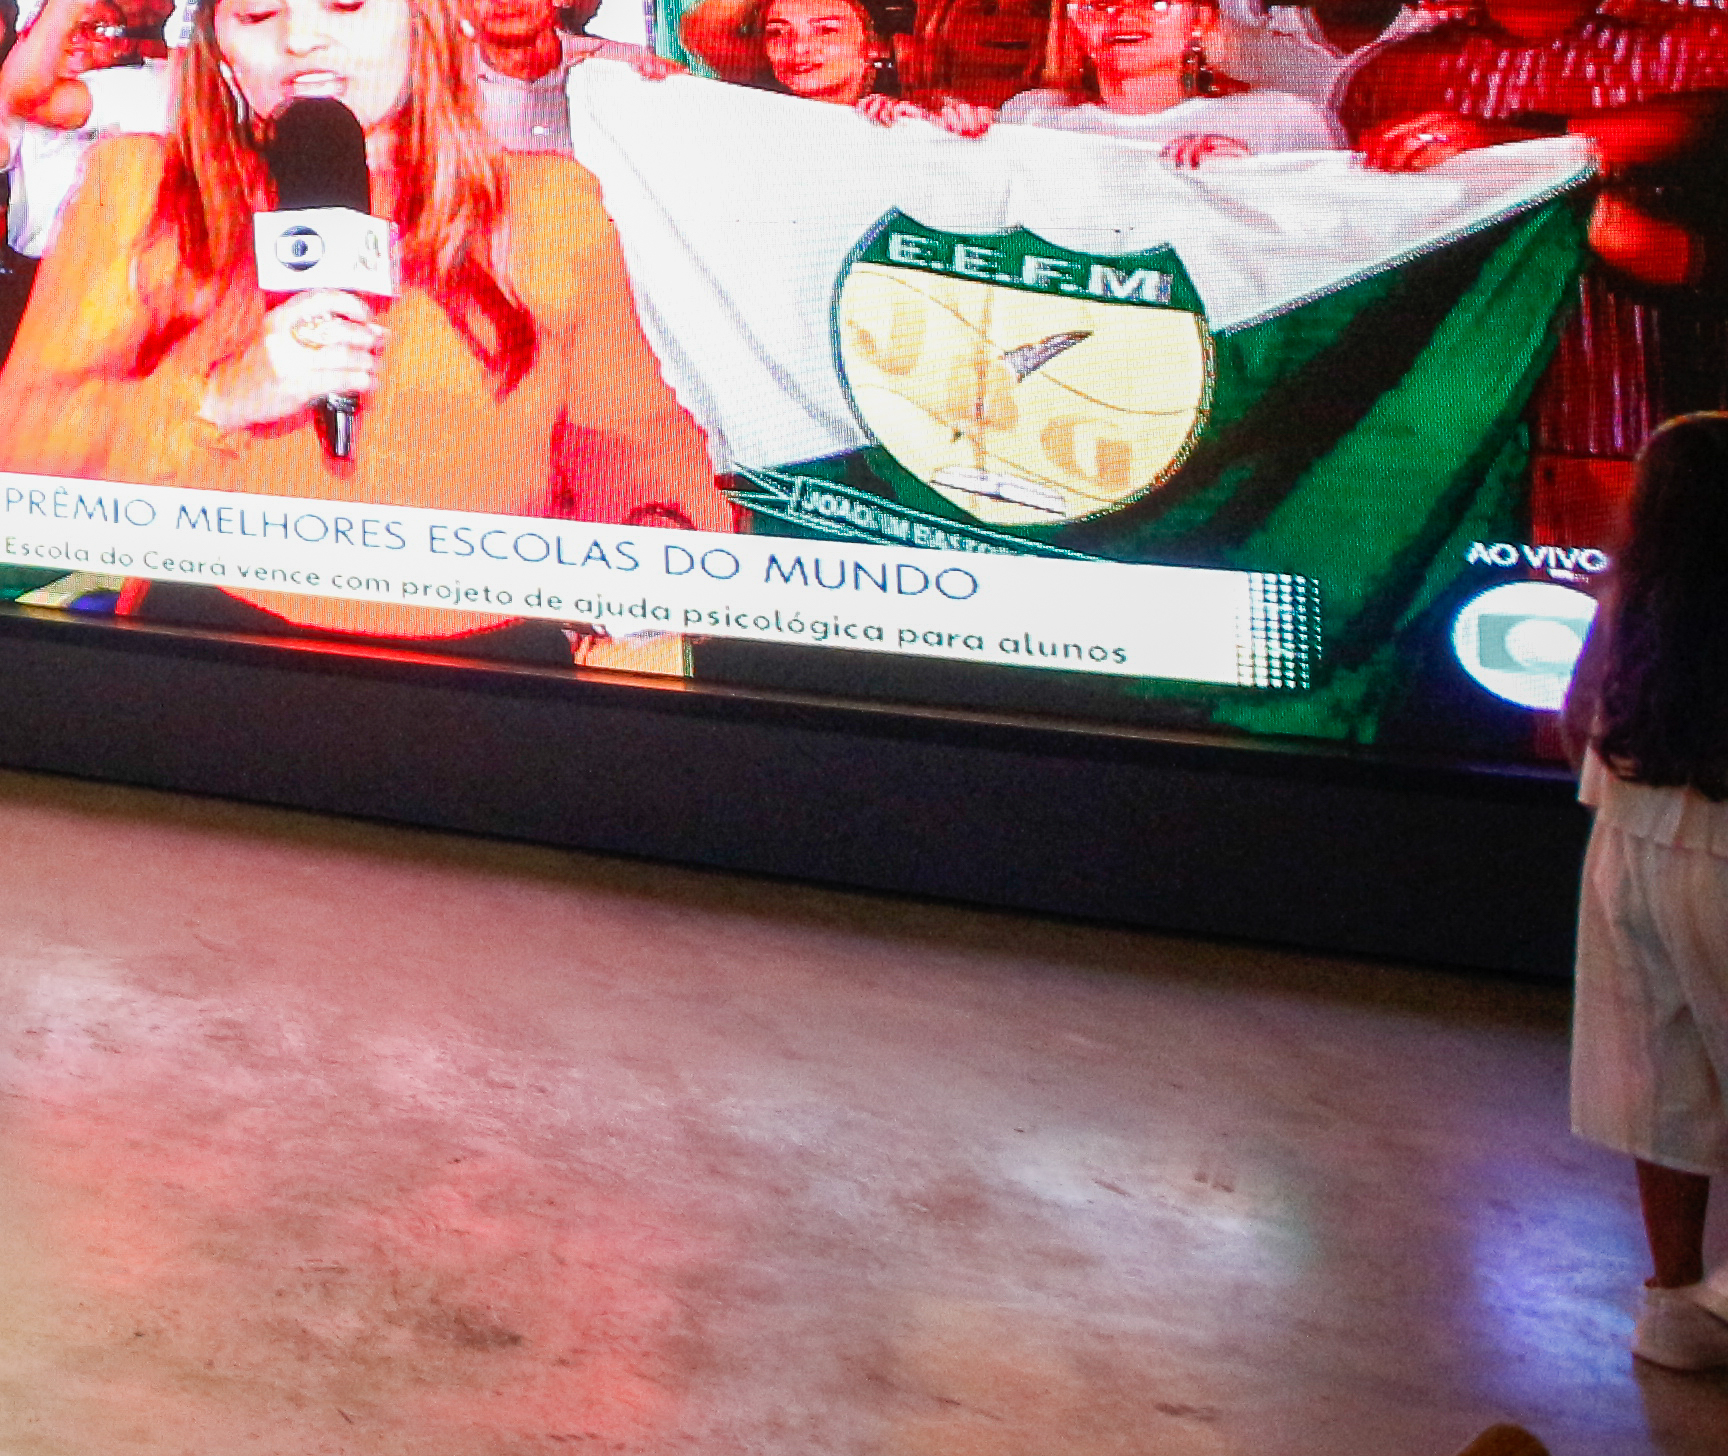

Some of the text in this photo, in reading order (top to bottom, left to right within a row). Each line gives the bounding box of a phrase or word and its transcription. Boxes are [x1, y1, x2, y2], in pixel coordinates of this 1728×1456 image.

[5, 485, 979, 601] PRÊMIO MELHORES ESCOLAS DO MUNDO
[5, 535, 1128, 665] Escola do Ceará vence com projeto de ajuda psicológica para alunos
[1464, 540, 1610, 574] AO VIVO
